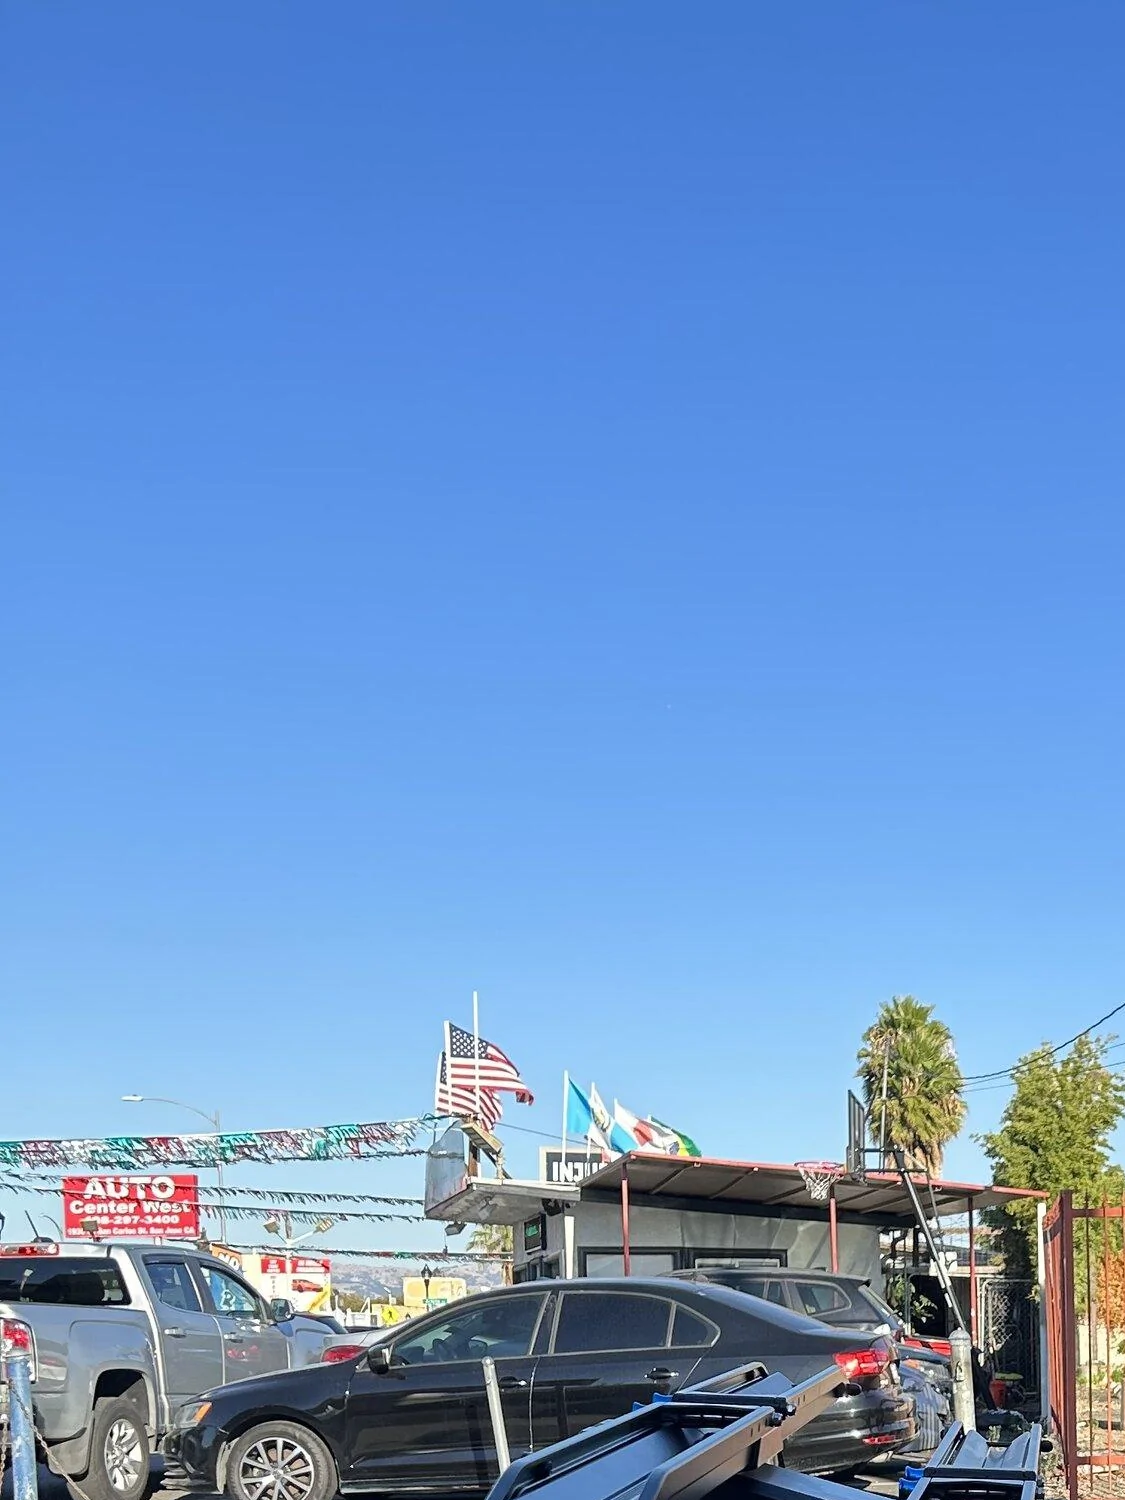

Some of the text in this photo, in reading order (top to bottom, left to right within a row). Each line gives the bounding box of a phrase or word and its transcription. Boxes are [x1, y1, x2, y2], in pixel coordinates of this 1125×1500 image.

[83, 1176, 175, 1200] AUTO
[69, 1199, 191, 1215] Center West
